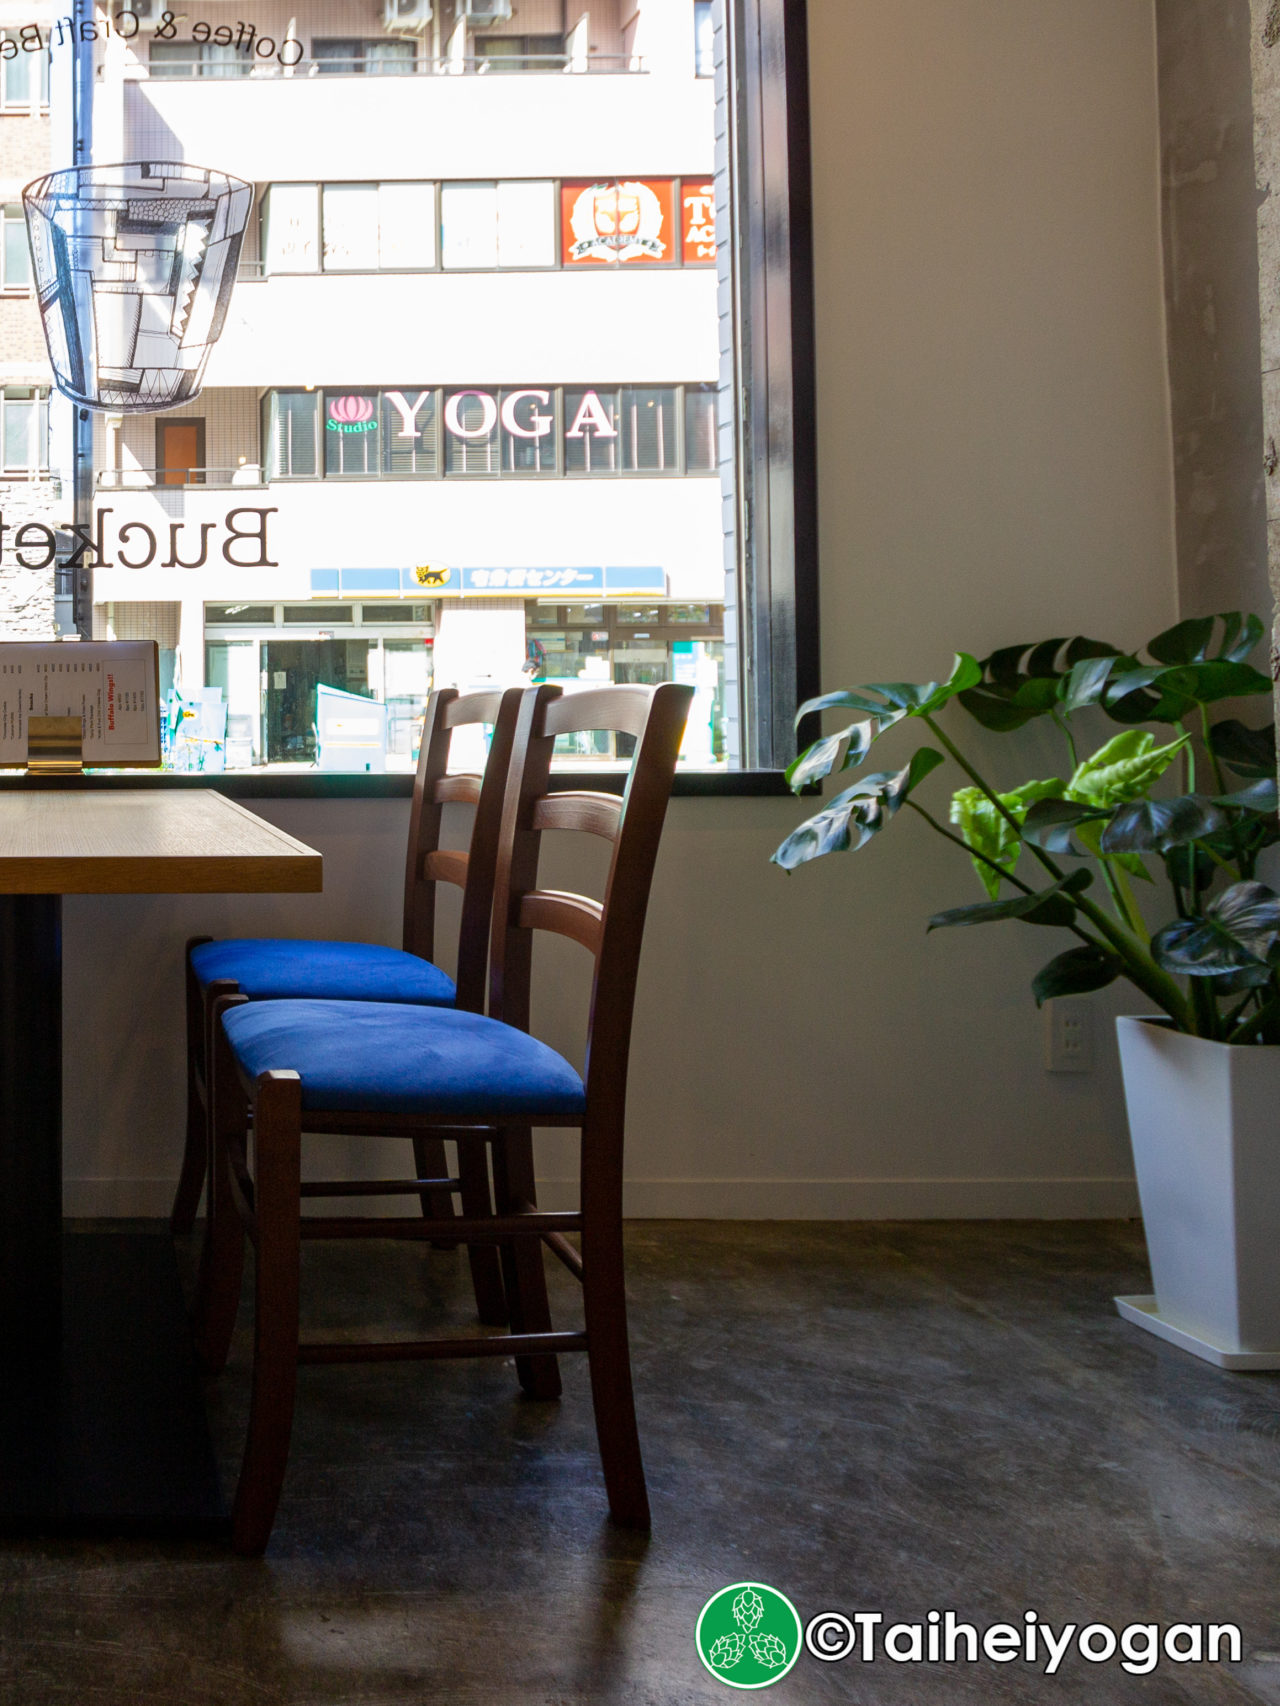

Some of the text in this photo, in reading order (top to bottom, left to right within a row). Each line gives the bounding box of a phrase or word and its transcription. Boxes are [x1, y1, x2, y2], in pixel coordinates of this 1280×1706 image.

[326, 389, 618, 439] Studio YOGA
[107, 702, 116, 731] Buffalo
